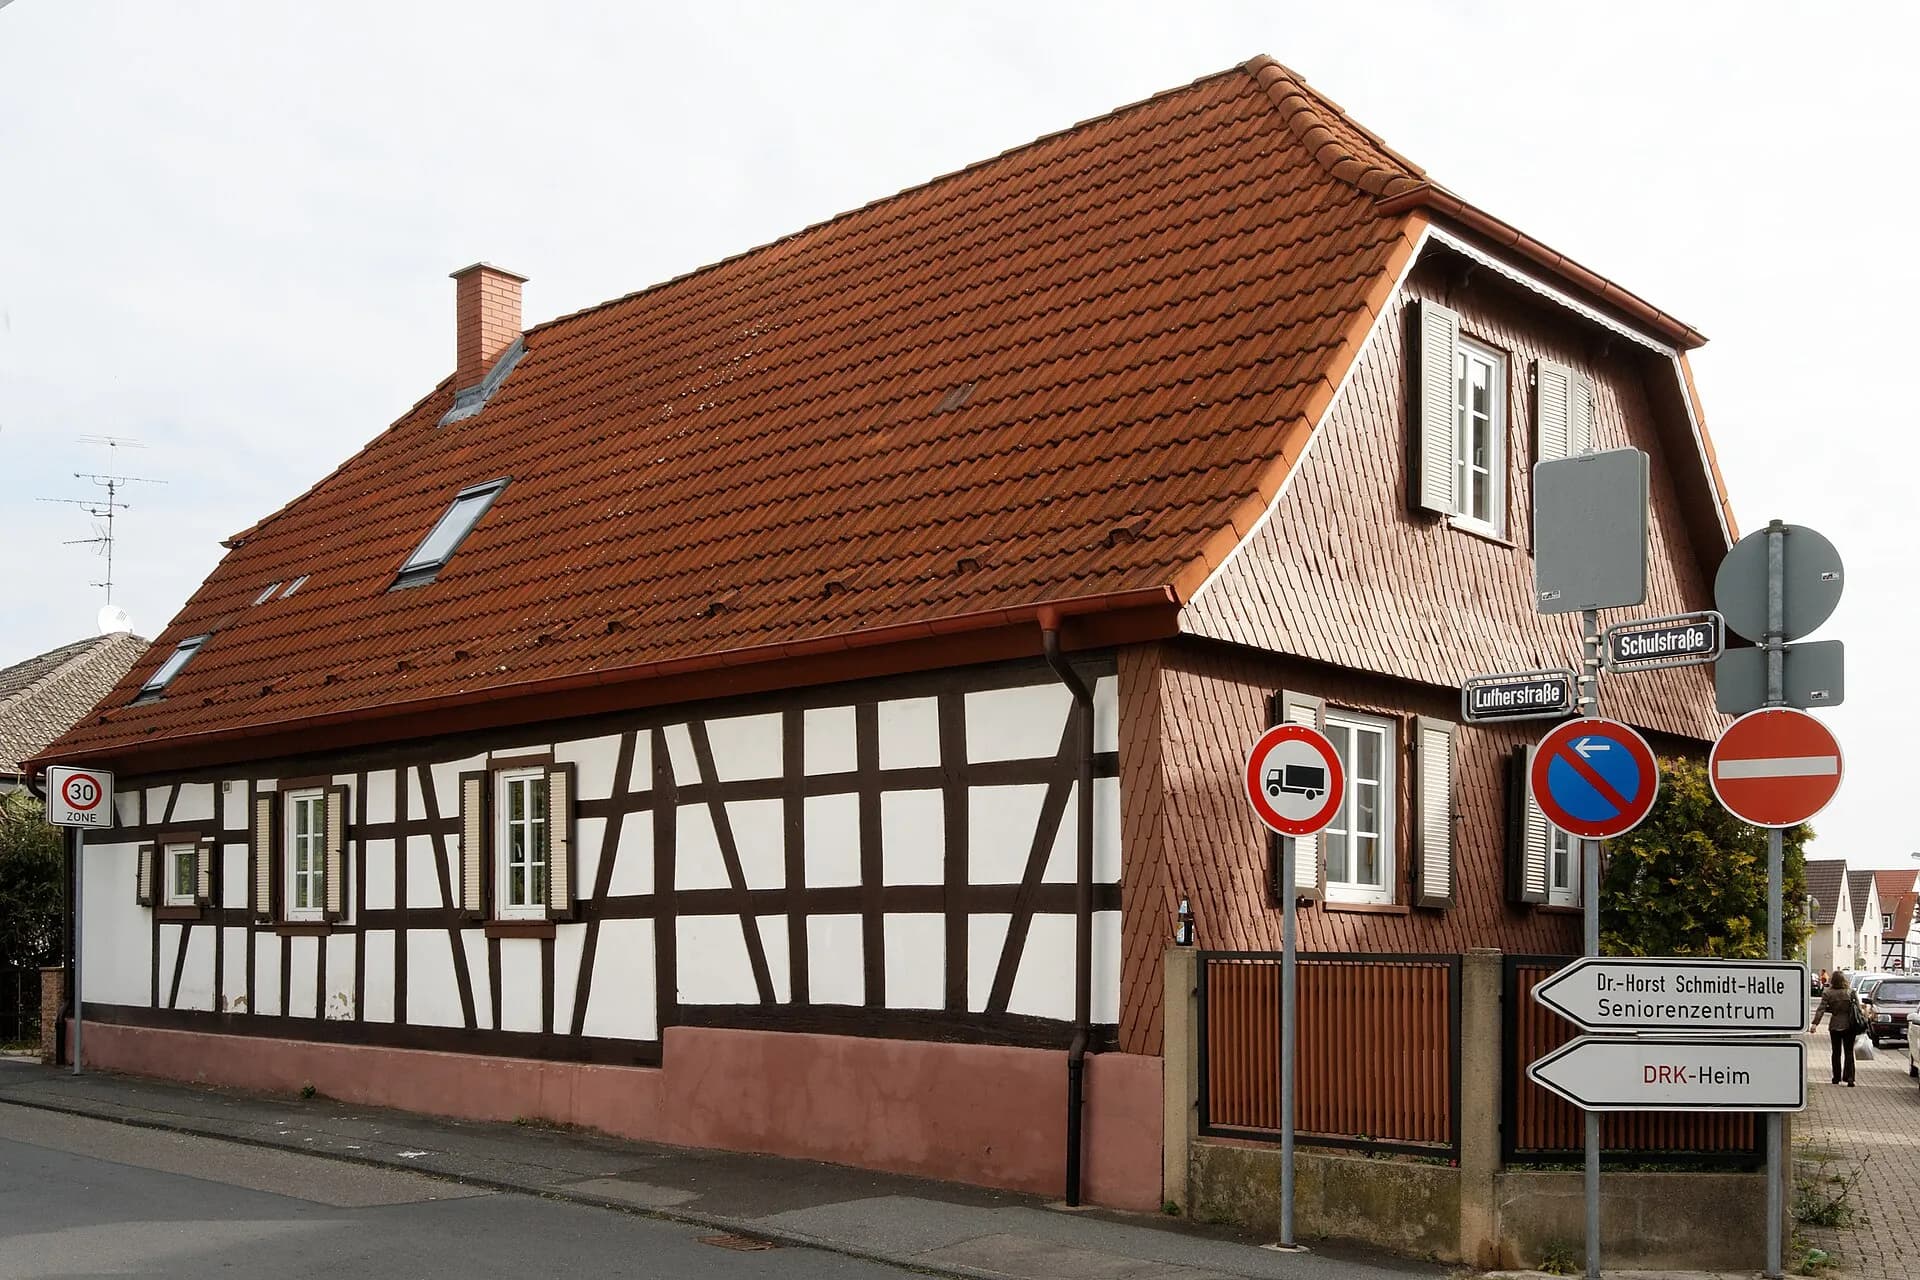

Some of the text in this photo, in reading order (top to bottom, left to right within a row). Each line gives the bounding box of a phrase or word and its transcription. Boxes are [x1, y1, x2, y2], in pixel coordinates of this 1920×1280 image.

[1621, 628, 1704, 656] Schulstraße
[1476, 683, 1560, 708] Lutherstraße
[70, 783, 94, 801] 30
[66, 811, 97, 823] ZONE
[1597, 973, 1785, 994] Dr.-Horst Schmidt-Halle
[1598, 999, 1775, 1020] Seniorenzentrum
[1644, 1065, 1750, 1085] DRK-Heim
